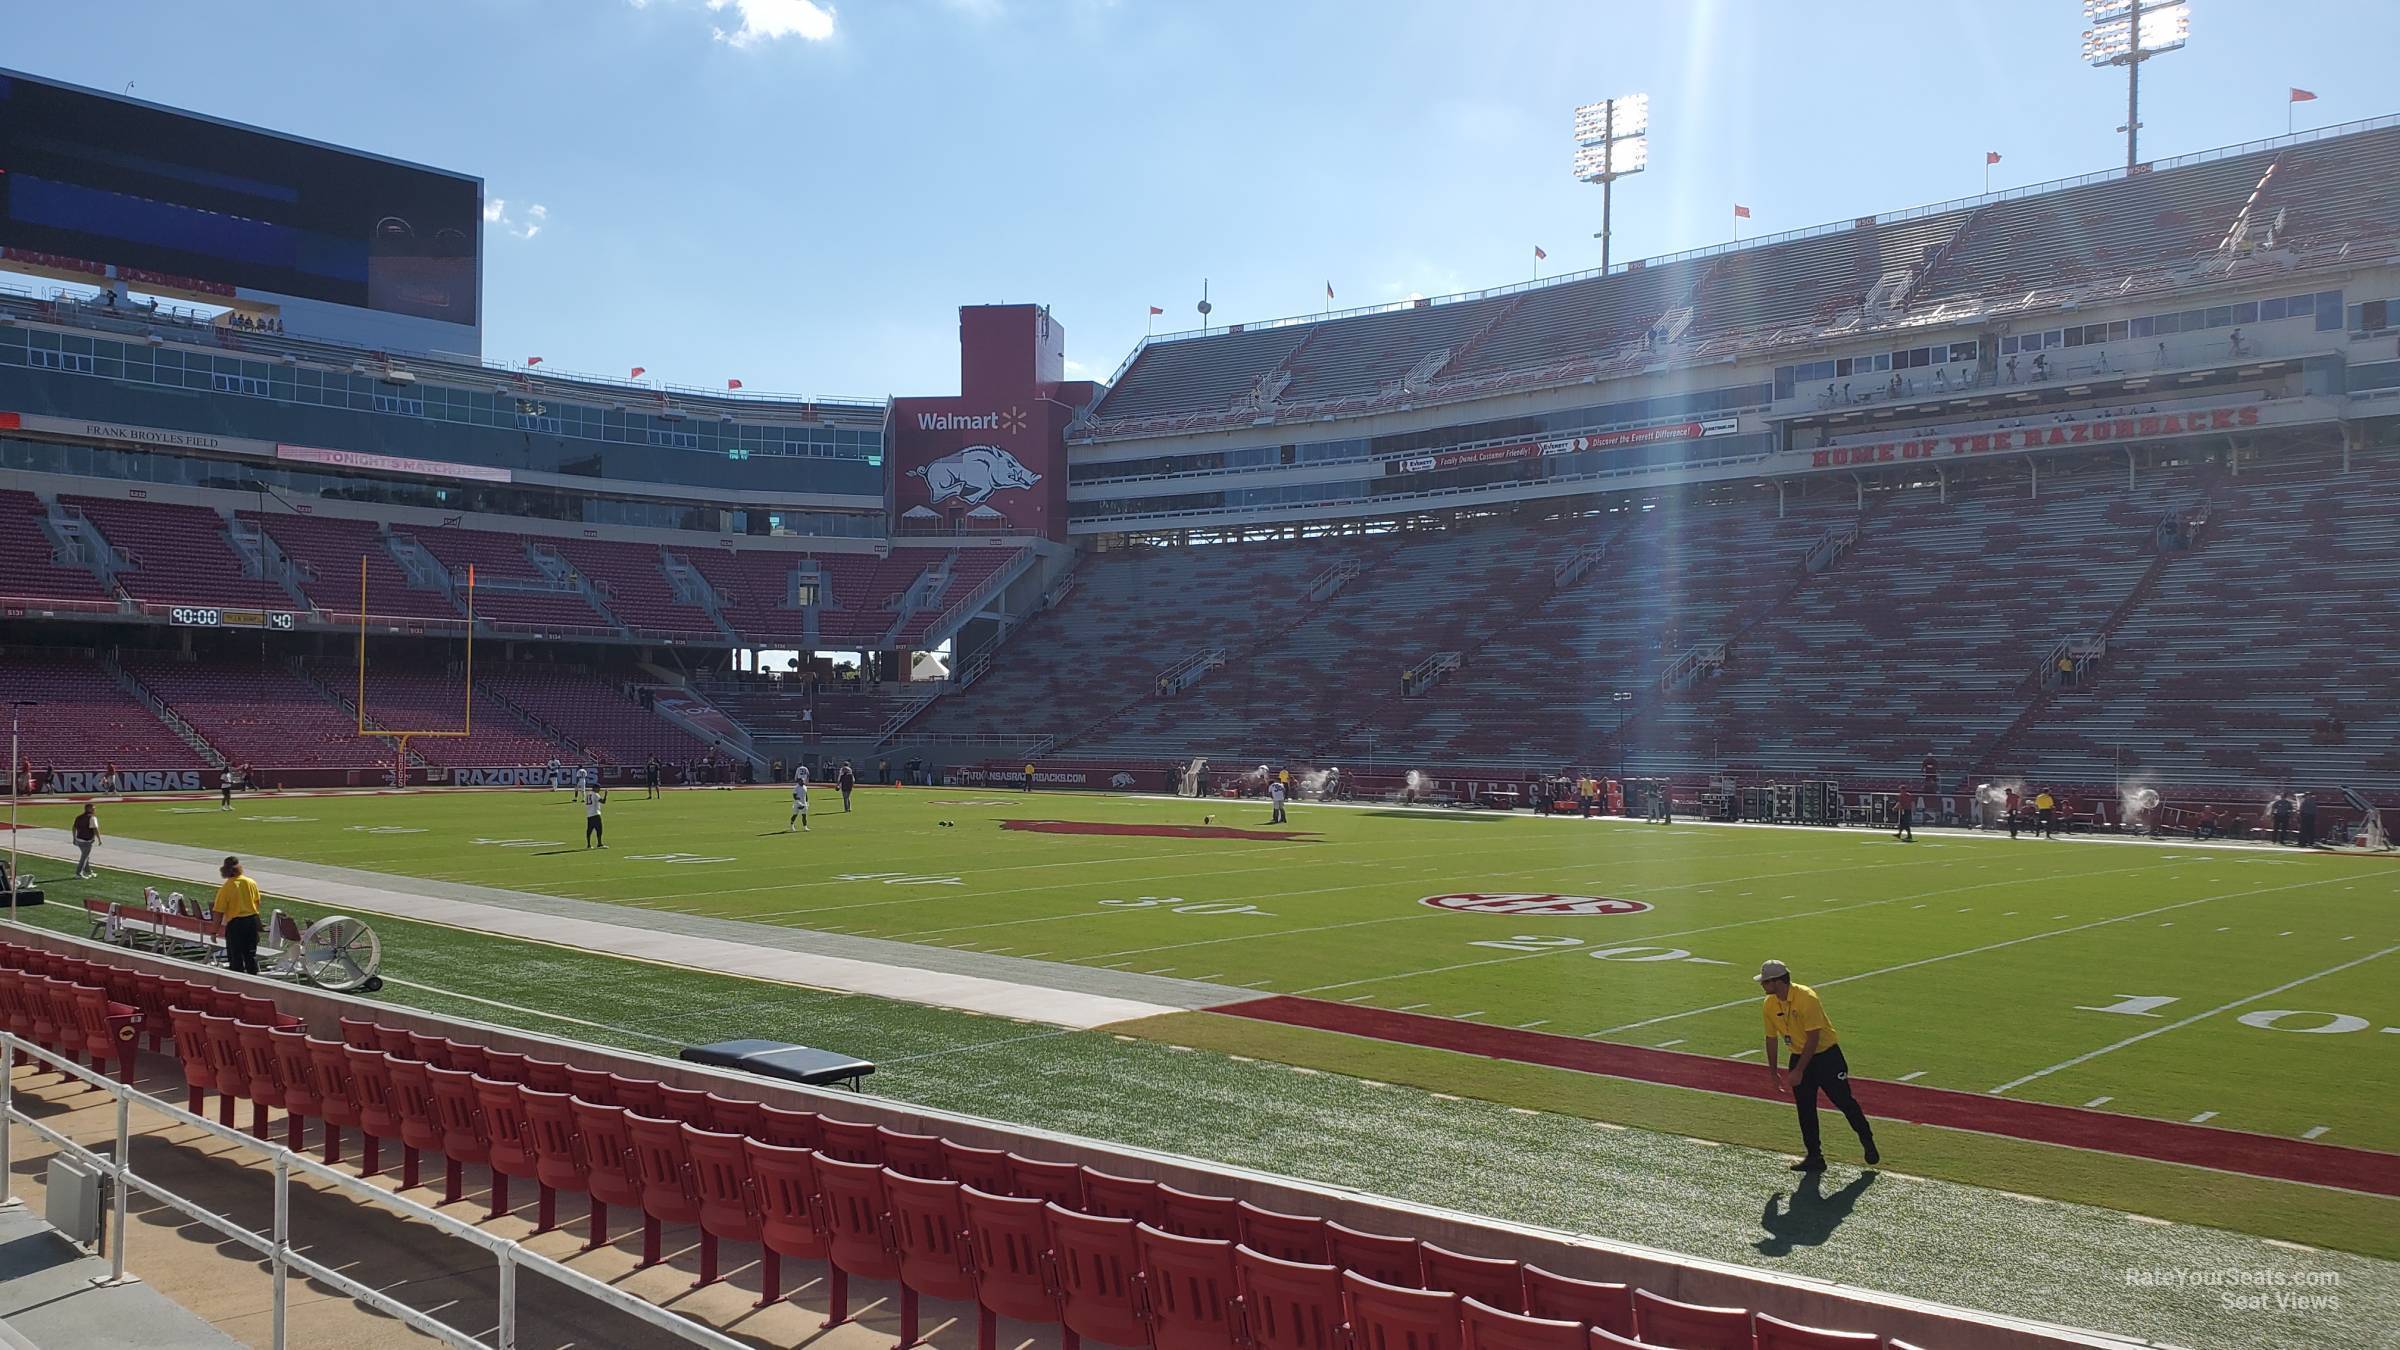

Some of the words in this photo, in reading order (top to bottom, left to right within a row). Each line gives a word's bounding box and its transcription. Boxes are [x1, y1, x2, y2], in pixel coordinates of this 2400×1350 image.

[917, 411, 999, 431] Walmart
[86, 425, 128, 439] FRANK
[129, 430, 184, 445] BROYLES
[185, 436, 219, 448] FIELD
[1812, 443, 1895, 468] HOME
[1901, 438, 1938, 460] OF
[1949, 432, 2012, 455] THE
[2024, 406, 2259, 447] RAZORBACKS
[172, 608, 217, 625] 90:00
[272, 614, 291, 628] 40
